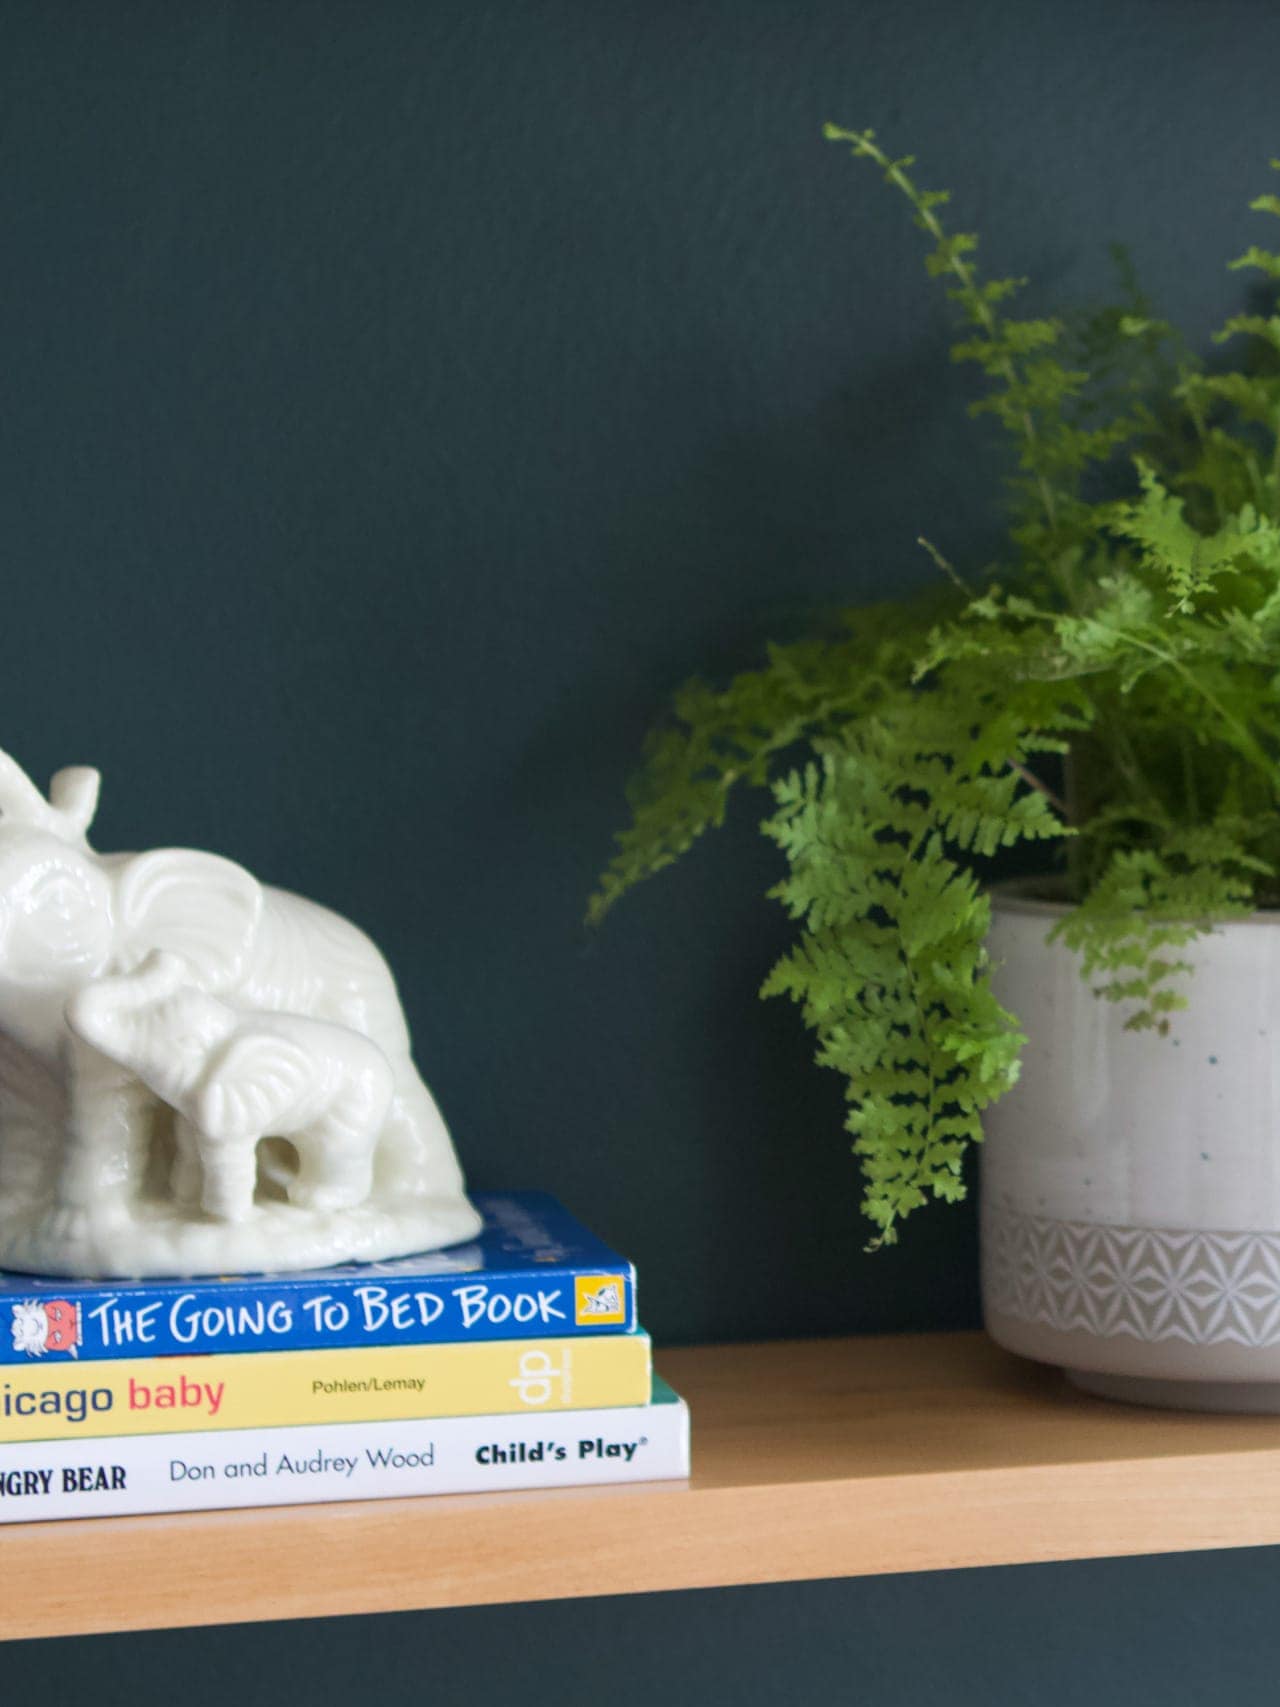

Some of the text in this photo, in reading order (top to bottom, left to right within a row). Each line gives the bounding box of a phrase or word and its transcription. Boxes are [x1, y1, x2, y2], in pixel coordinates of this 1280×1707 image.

[88, 1285, 566, 1347] THE GOING TO BED BOOK
[129, 1375, 224, 1415] baby
[312, 1377, 425, 1394] Pohlen/Lemay
[170, 1443, 434, 1481] Don and Audrey Wood
[476, 1441, 567, 1465] Child's
[63, 1466, 126, 1493] BEAR
